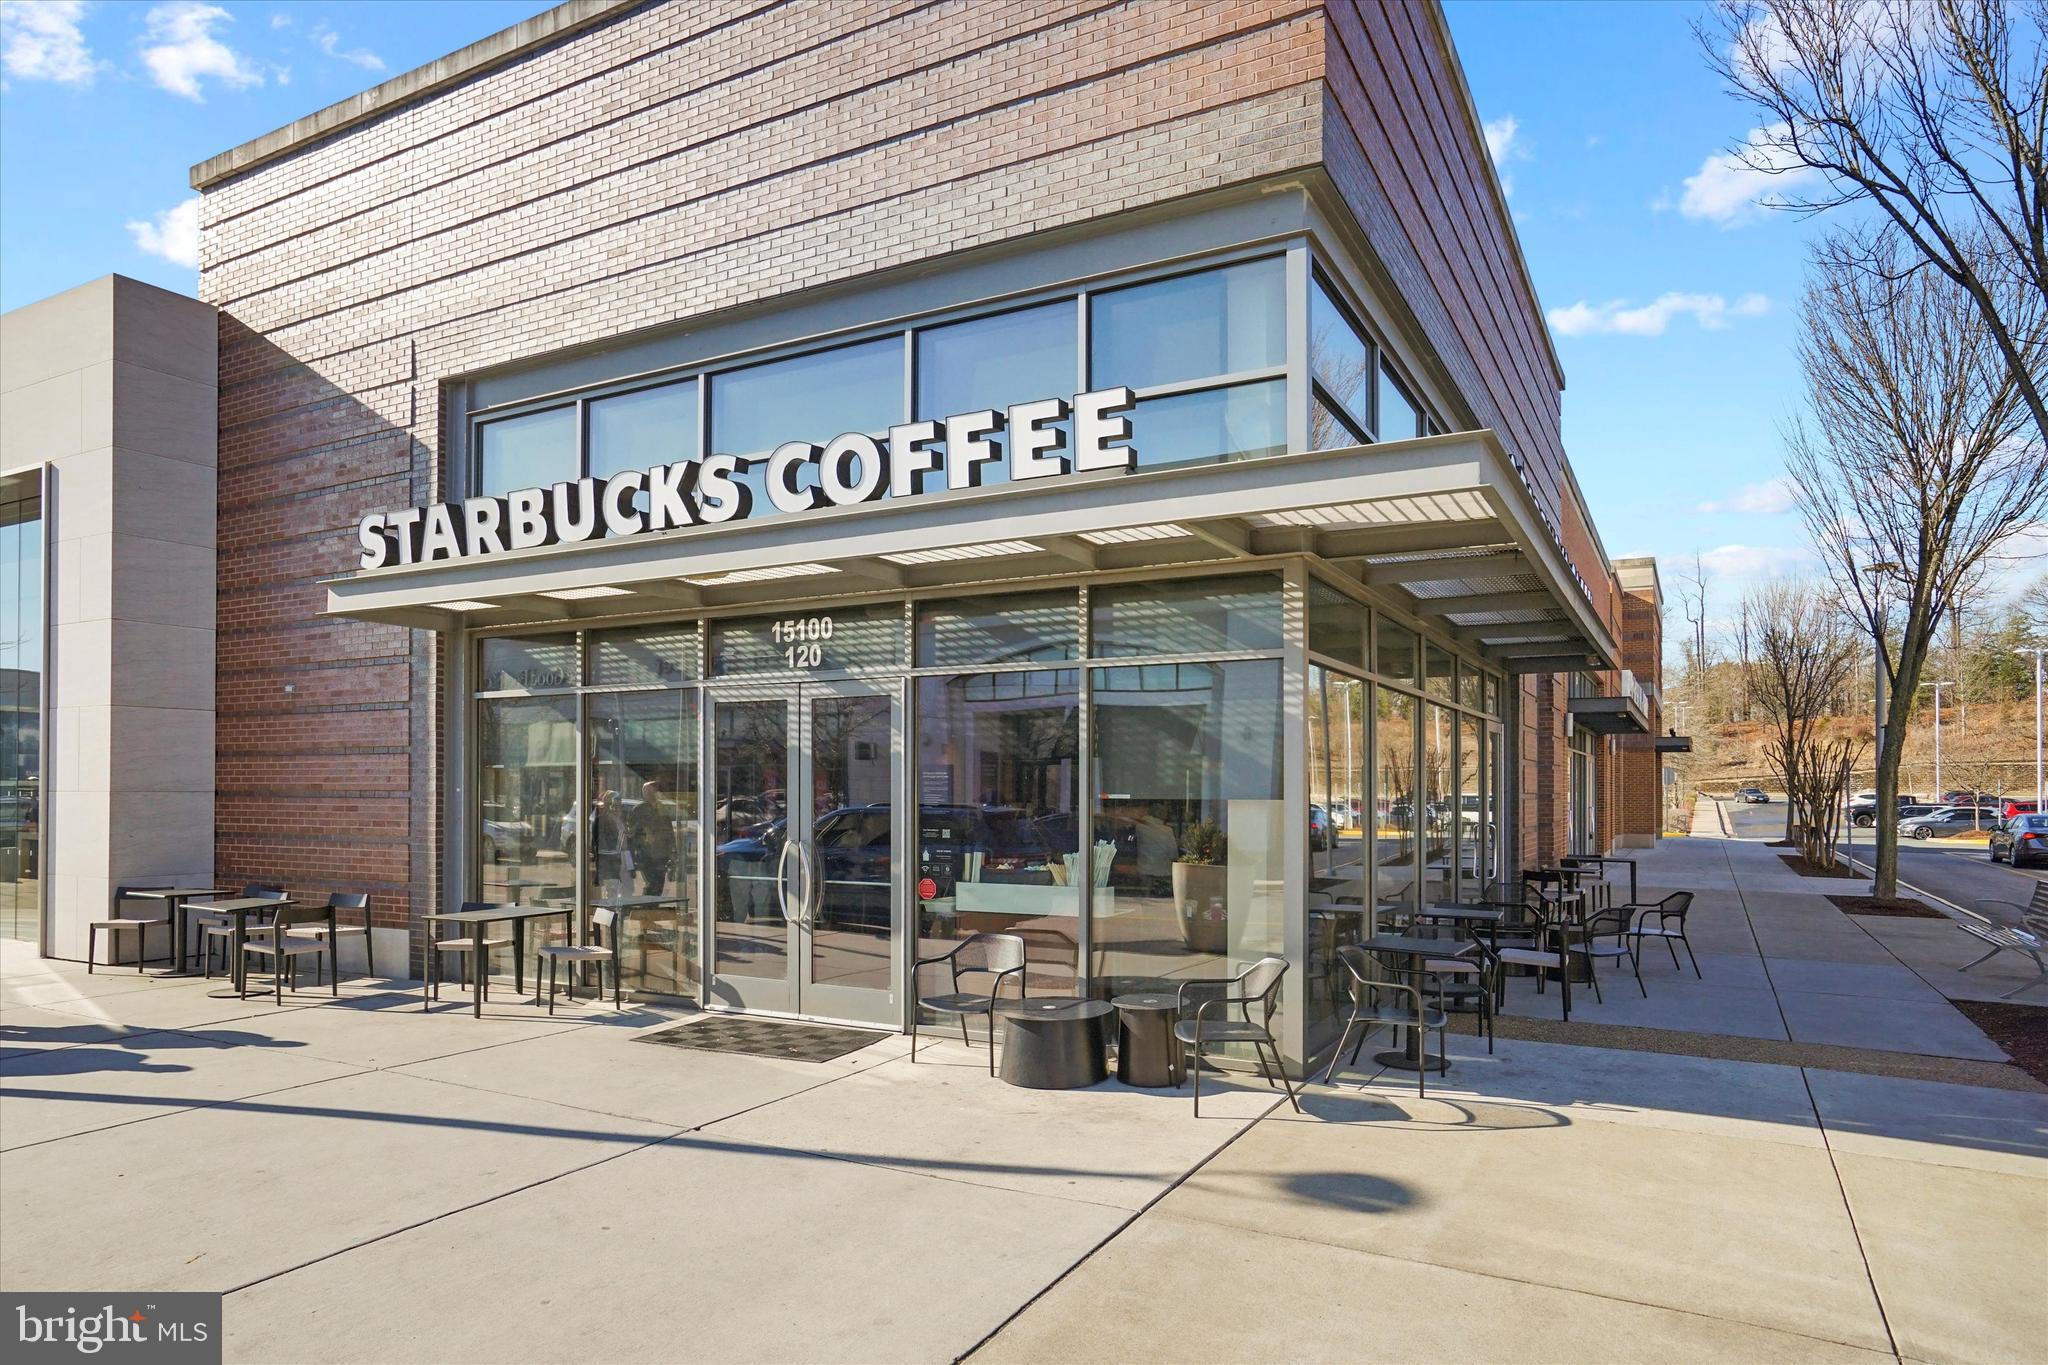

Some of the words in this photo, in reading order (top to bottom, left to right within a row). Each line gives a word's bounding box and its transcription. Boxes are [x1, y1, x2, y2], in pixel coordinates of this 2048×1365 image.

[358, 453, 750, 570] STARBUCKS
[765, 385, 1136, 513] COFFEE
[771, 616, 833, 643] 15100
[785, 644, 822, 668] 120
